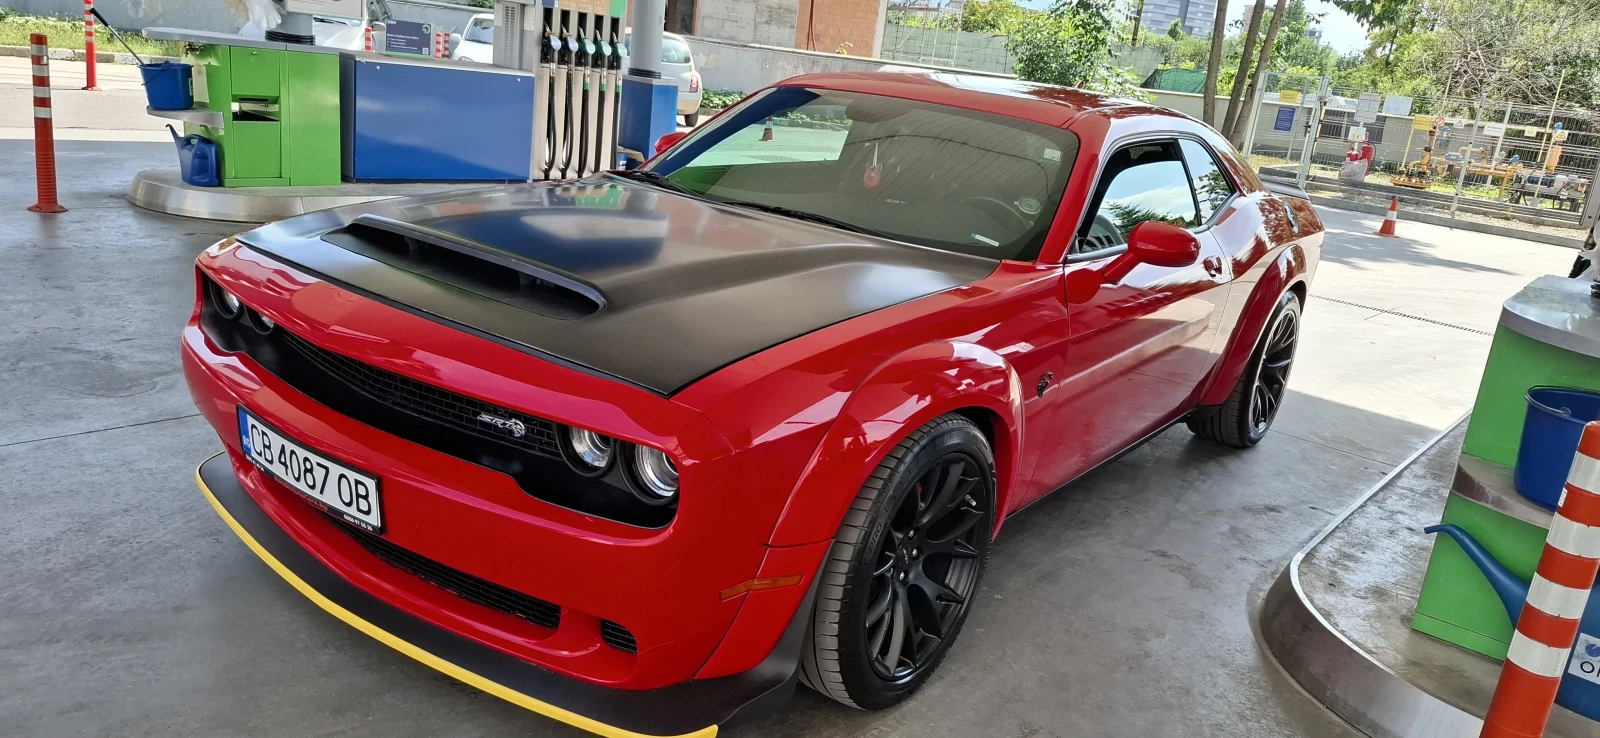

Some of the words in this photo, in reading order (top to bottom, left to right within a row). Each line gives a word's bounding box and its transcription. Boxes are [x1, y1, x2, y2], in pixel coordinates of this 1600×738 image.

[477, 412, 515, 431] SRT
[250, 423, 274, 465] CB
[278, 442, 330, 496] 4087
[337, 472, 372, 516] OB
[1580, 660, 1600, 678] O
